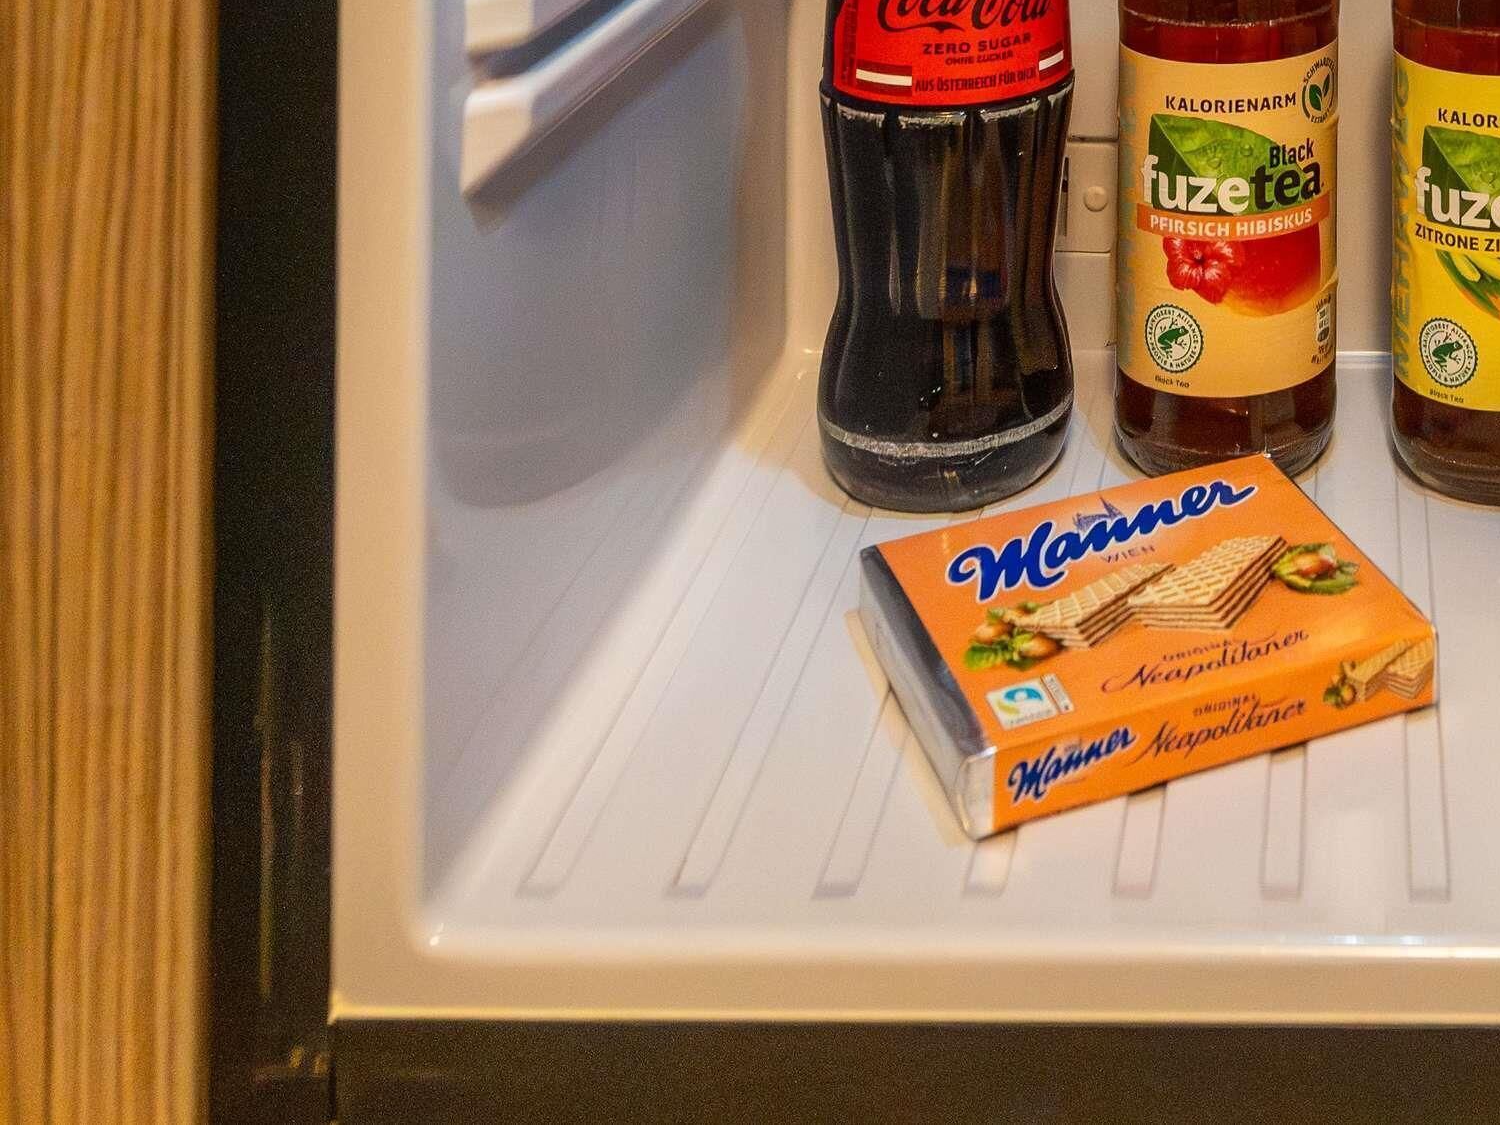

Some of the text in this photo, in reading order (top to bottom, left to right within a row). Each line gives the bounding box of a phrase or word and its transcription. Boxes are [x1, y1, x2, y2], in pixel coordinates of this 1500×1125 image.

[922, 32, 1032, 56] ZERO SUGAR
[915, 79, 934, 92] AUS
[937, 75, 997, 92] ÖSTERREICH
[1000, 71, 1017, 86] FÜR
[1165, 91, 1297, 114] KALORIENARM
[1269, 137, 1314, 169] Black
[1150, 208, 1313, 237] PFIRSICH HIBISKUS
[1415, 222, 1479, 251] ZITRONE
[948, 480, 1256, 602] Manner
[1101, 630, 1309, 693] Neapolitaner
[1122, 696, 1307, 769] Neapolitaner
[1007, 727, 1137, 803] Manner
